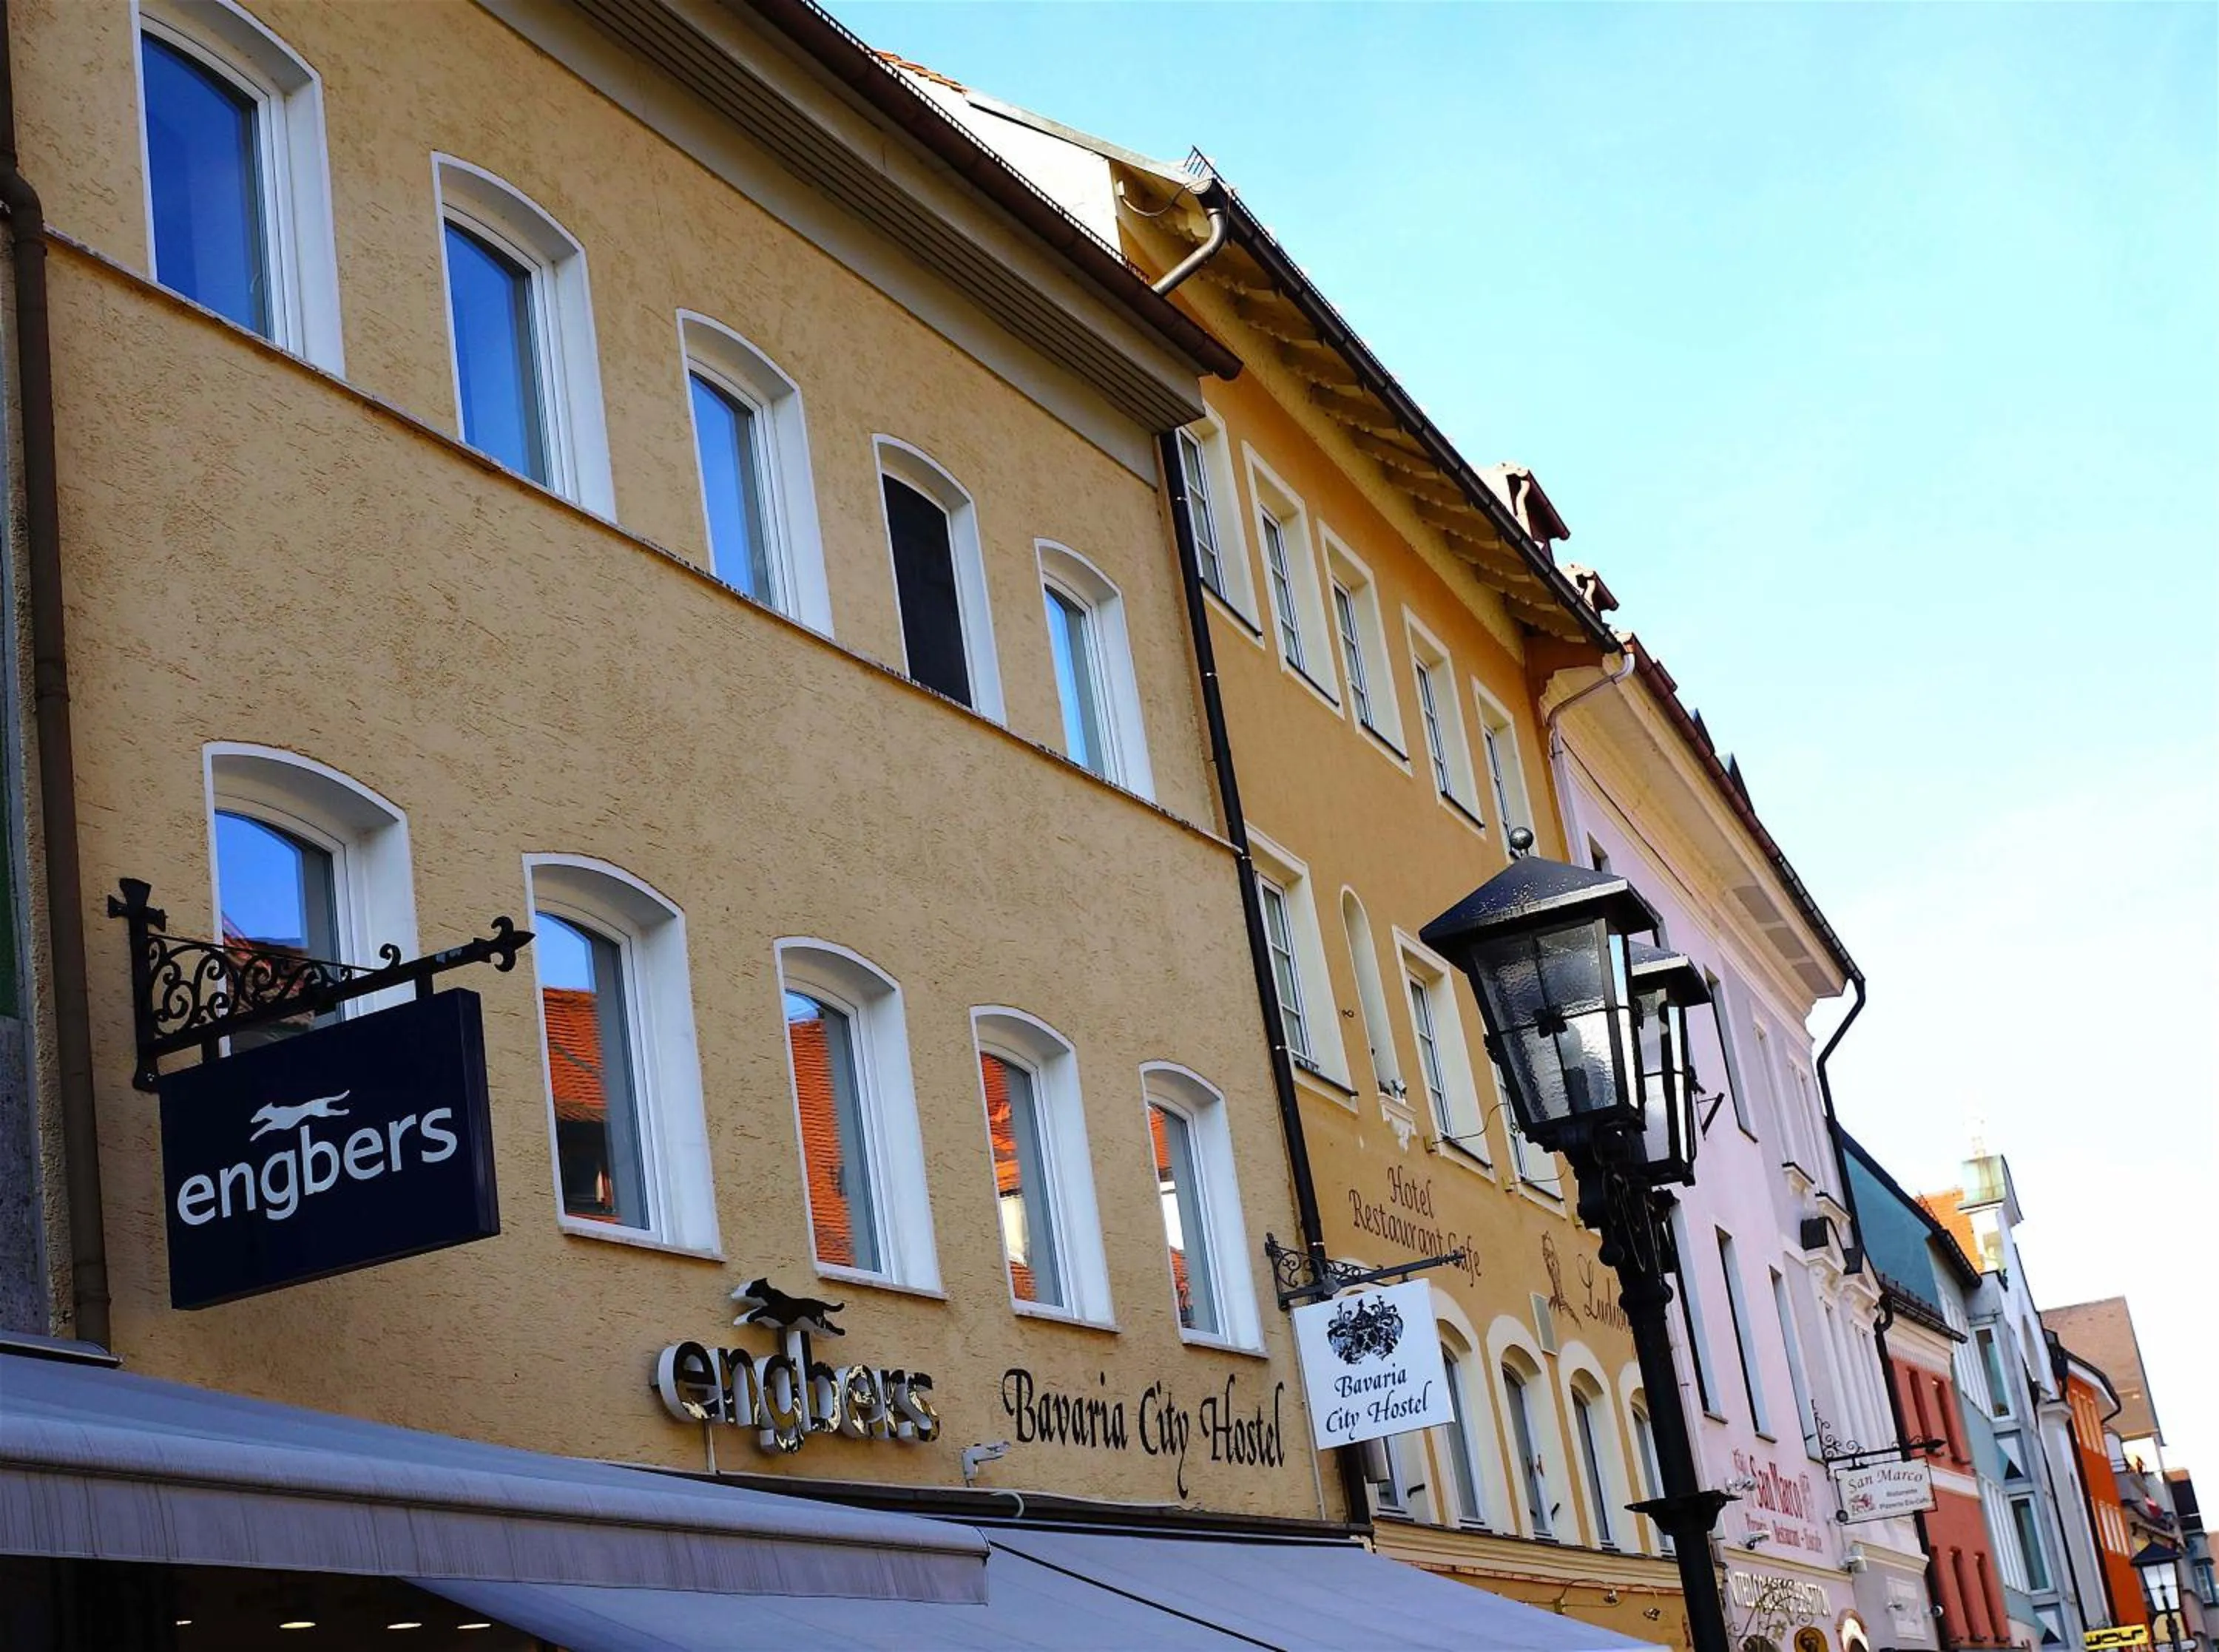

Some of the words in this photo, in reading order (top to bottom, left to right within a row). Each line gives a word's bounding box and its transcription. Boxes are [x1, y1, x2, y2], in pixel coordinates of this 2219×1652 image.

[177, 1107, 458, 1225] engbers
[1387, 1164, 1434, 1219] Hotel
[1348, 1188, 1443, 1257] Restaurant
[657, 1331, 940, 1454] engbers
[1325, 1406, 1360, 1441] City
[1368, 1380, 1432, 1424] Hostel
[1334, 1363, 1407, 1398] Bavaria
[1002, 1368, 1129, 1450] Bavaria
[1138, 1380, 1189, 1500] City
[1199, 1372, 1285, 1468] Hostel
[1848, 1475, 1873, 1493] San
[1877, 1468, 1922, 1483] Marco
